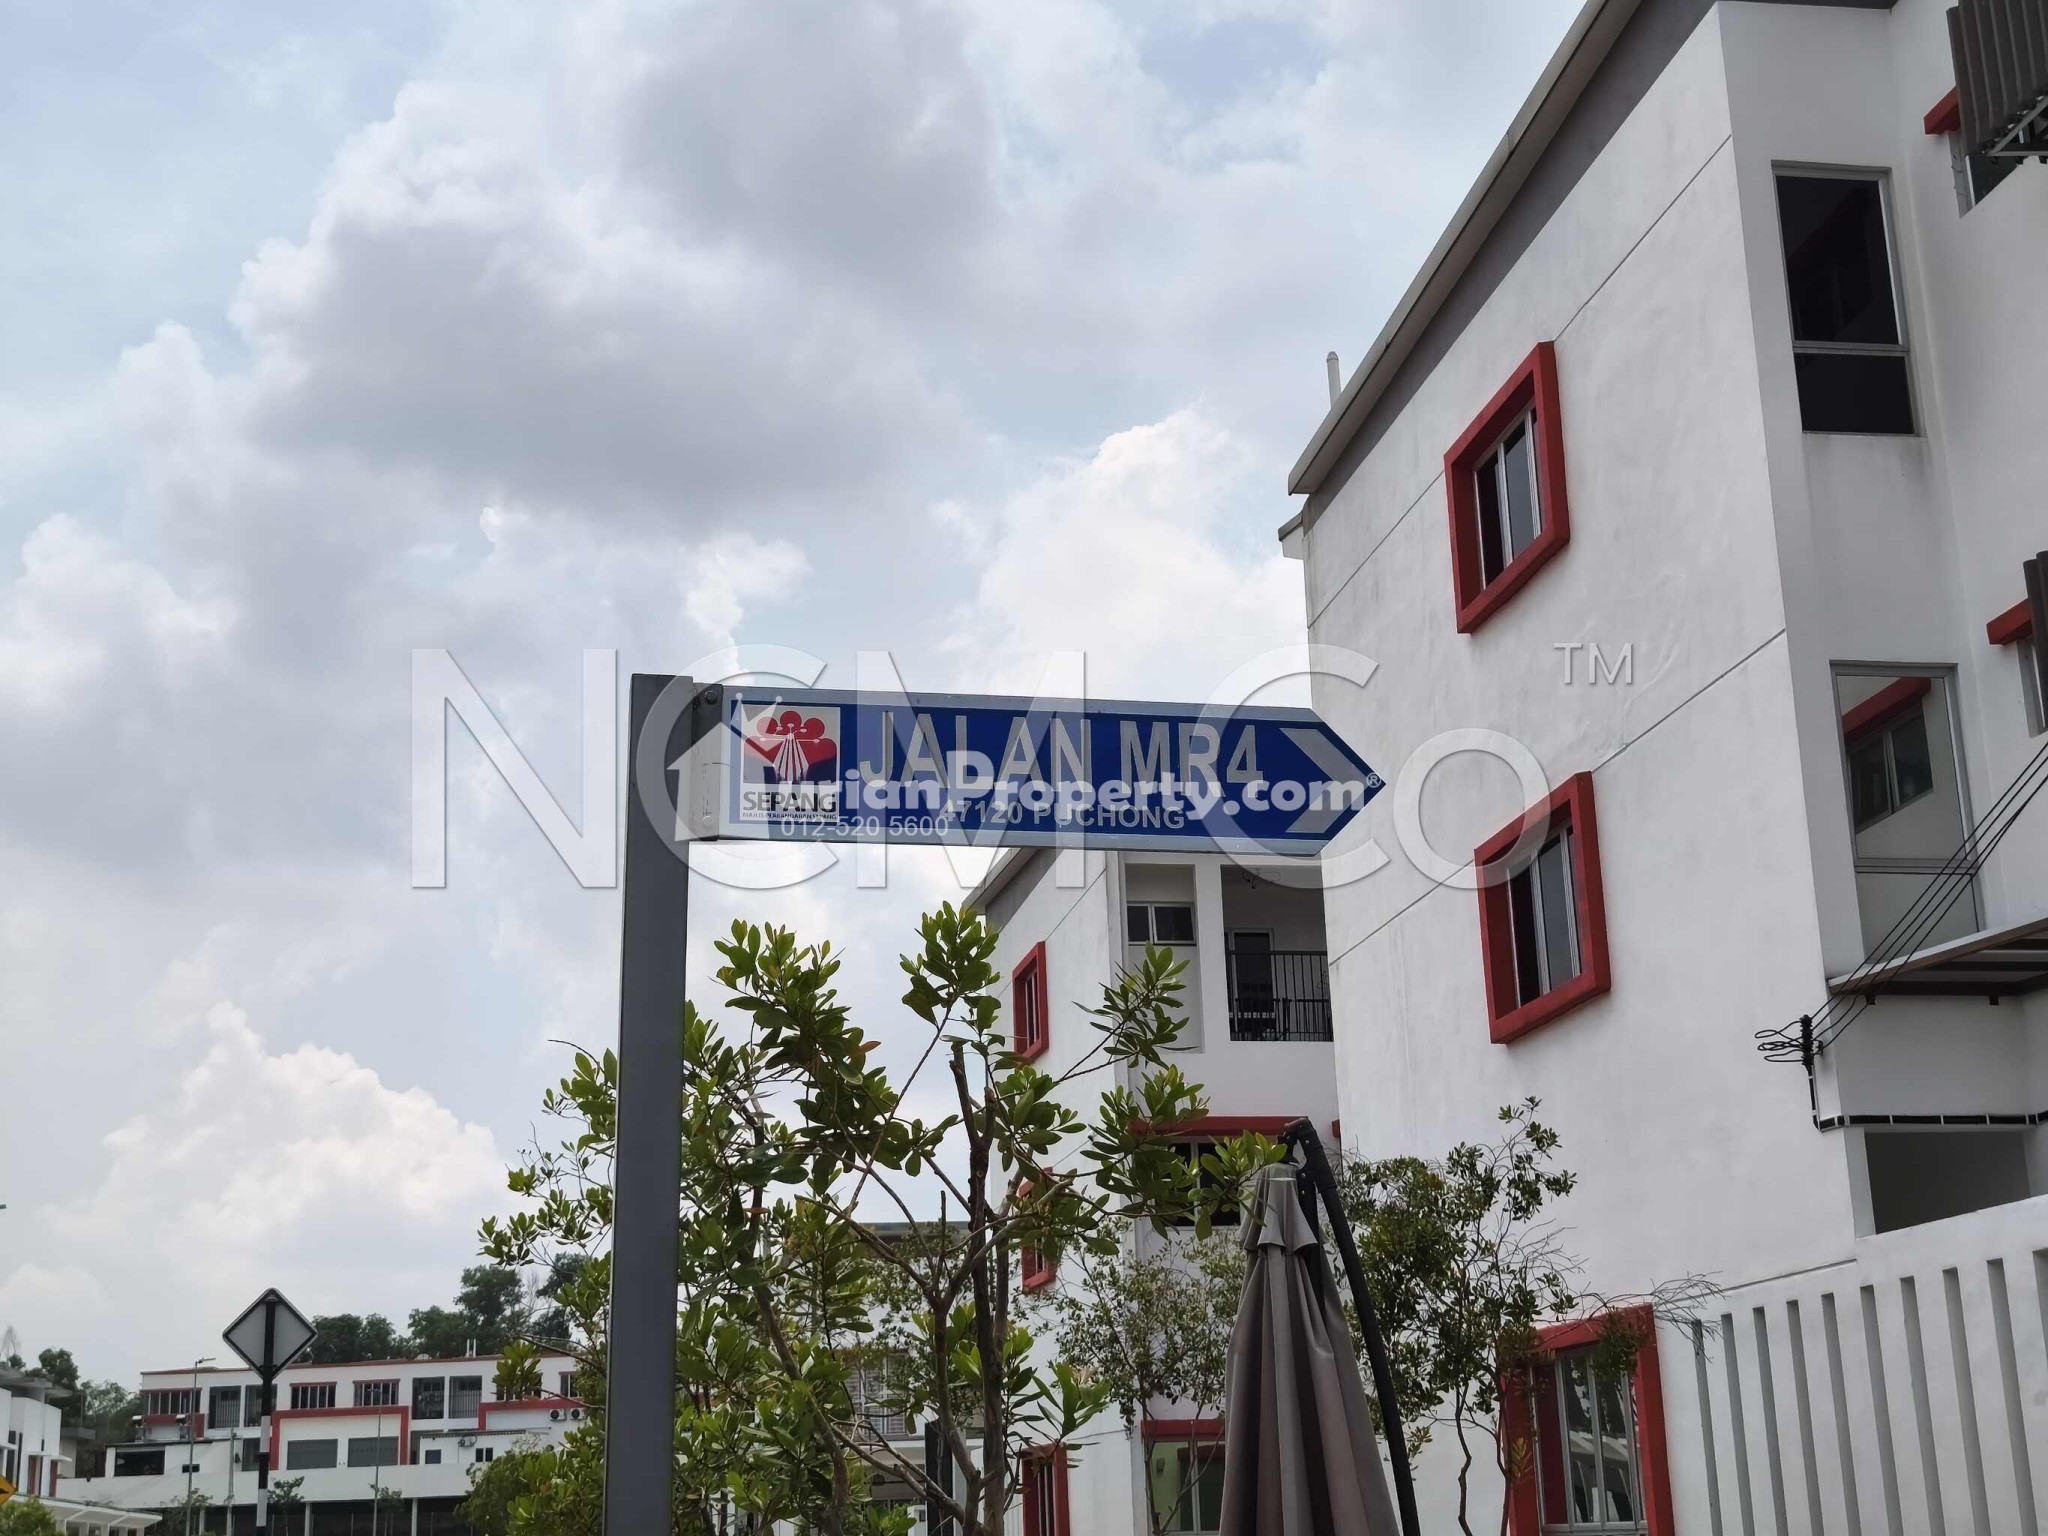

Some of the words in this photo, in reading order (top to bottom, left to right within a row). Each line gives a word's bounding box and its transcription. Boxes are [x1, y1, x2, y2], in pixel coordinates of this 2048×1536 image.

[859, 711, 1093, 793] JALAN
[1119, 720, 1264, 798] MR4
[742, 791, 837, 812] SEPANG
[938, 799, 1023, 823] 47120
[1033, 802, 1185, 829] PUCHONG
